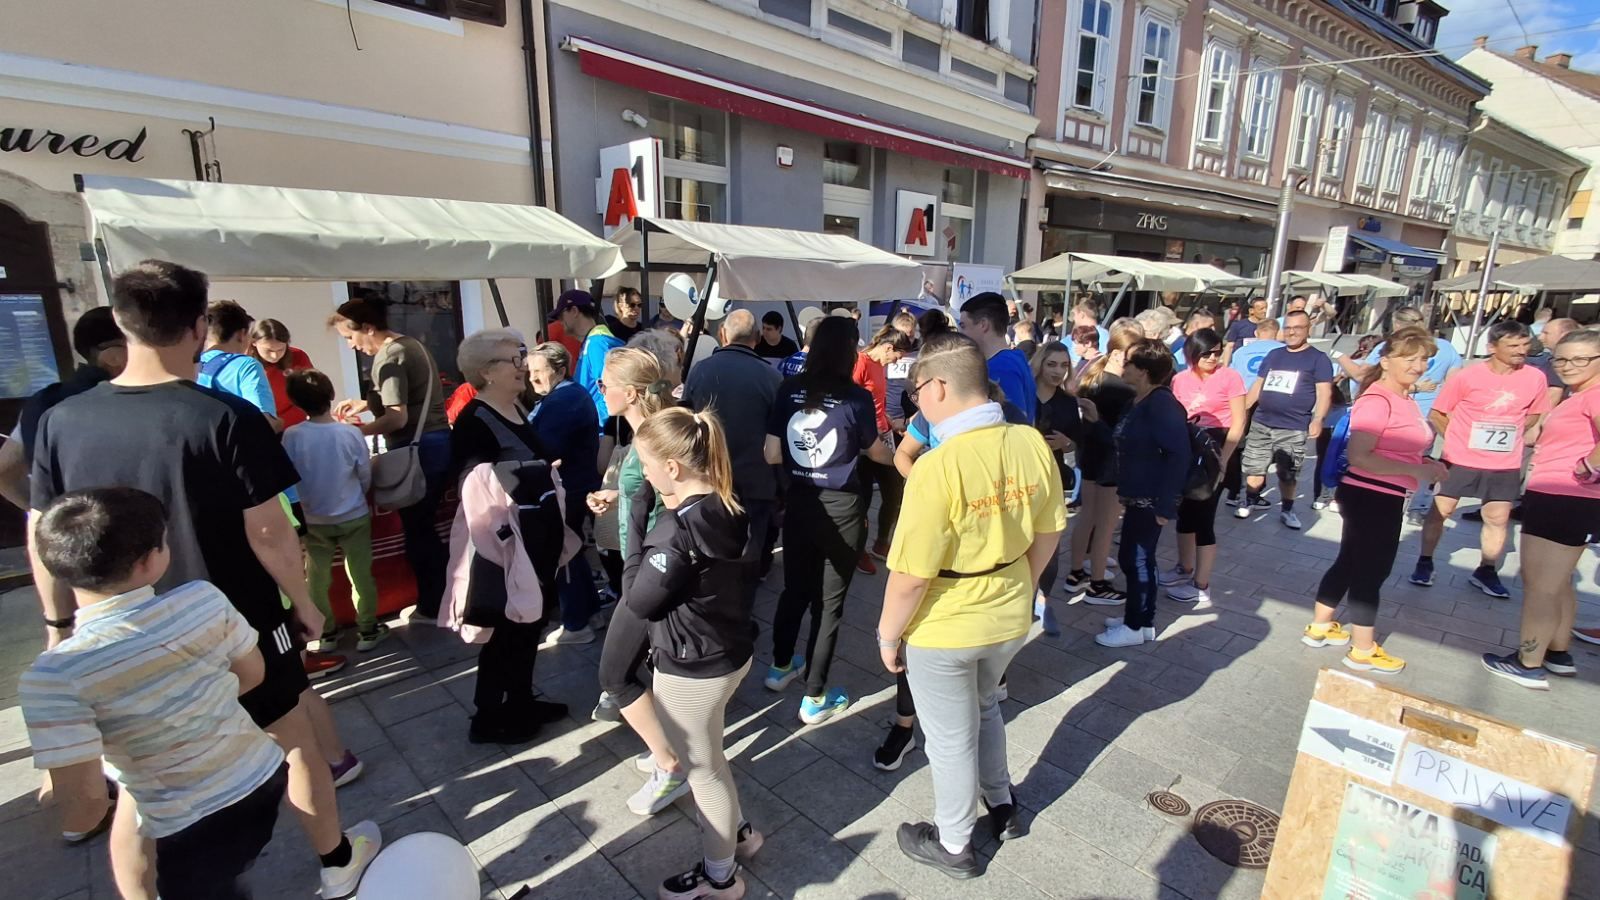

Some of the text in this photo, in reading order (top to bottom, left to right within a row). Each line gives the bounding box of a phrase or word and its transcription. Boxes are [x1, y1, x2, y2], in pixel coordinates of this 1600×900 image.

[604, 155, 645, 225] A1
[904, 203, 934, 246] A1
[1136, 212, 1167, 231] ZAKS
[1484, 430, 1509, 446] 72
[969, 492, 1004, 513] SPOR
[1414, 750, 1564, 832] PRIJAVE
